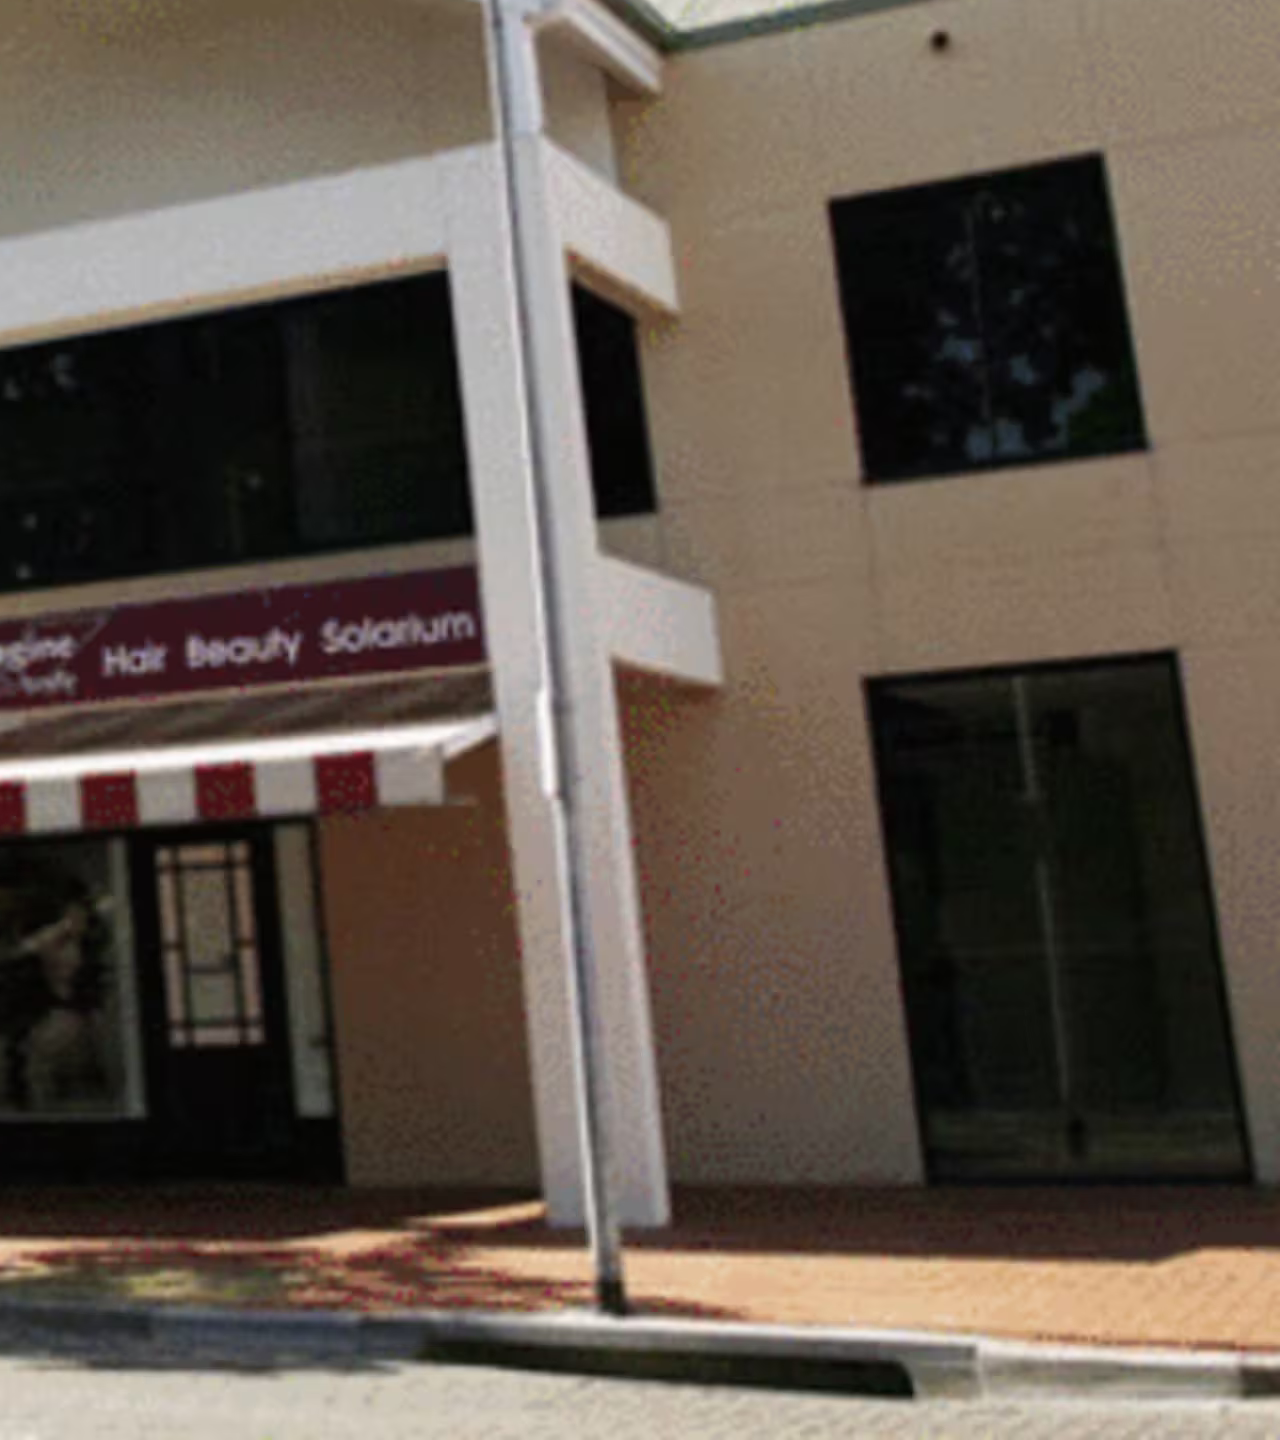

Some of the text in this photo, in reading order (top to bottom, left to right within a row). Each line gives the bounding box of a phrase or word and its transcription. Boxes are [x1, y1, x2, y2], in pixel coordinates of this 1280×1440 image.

[102, 610, 476, 677] Hair Beauty Solarium
